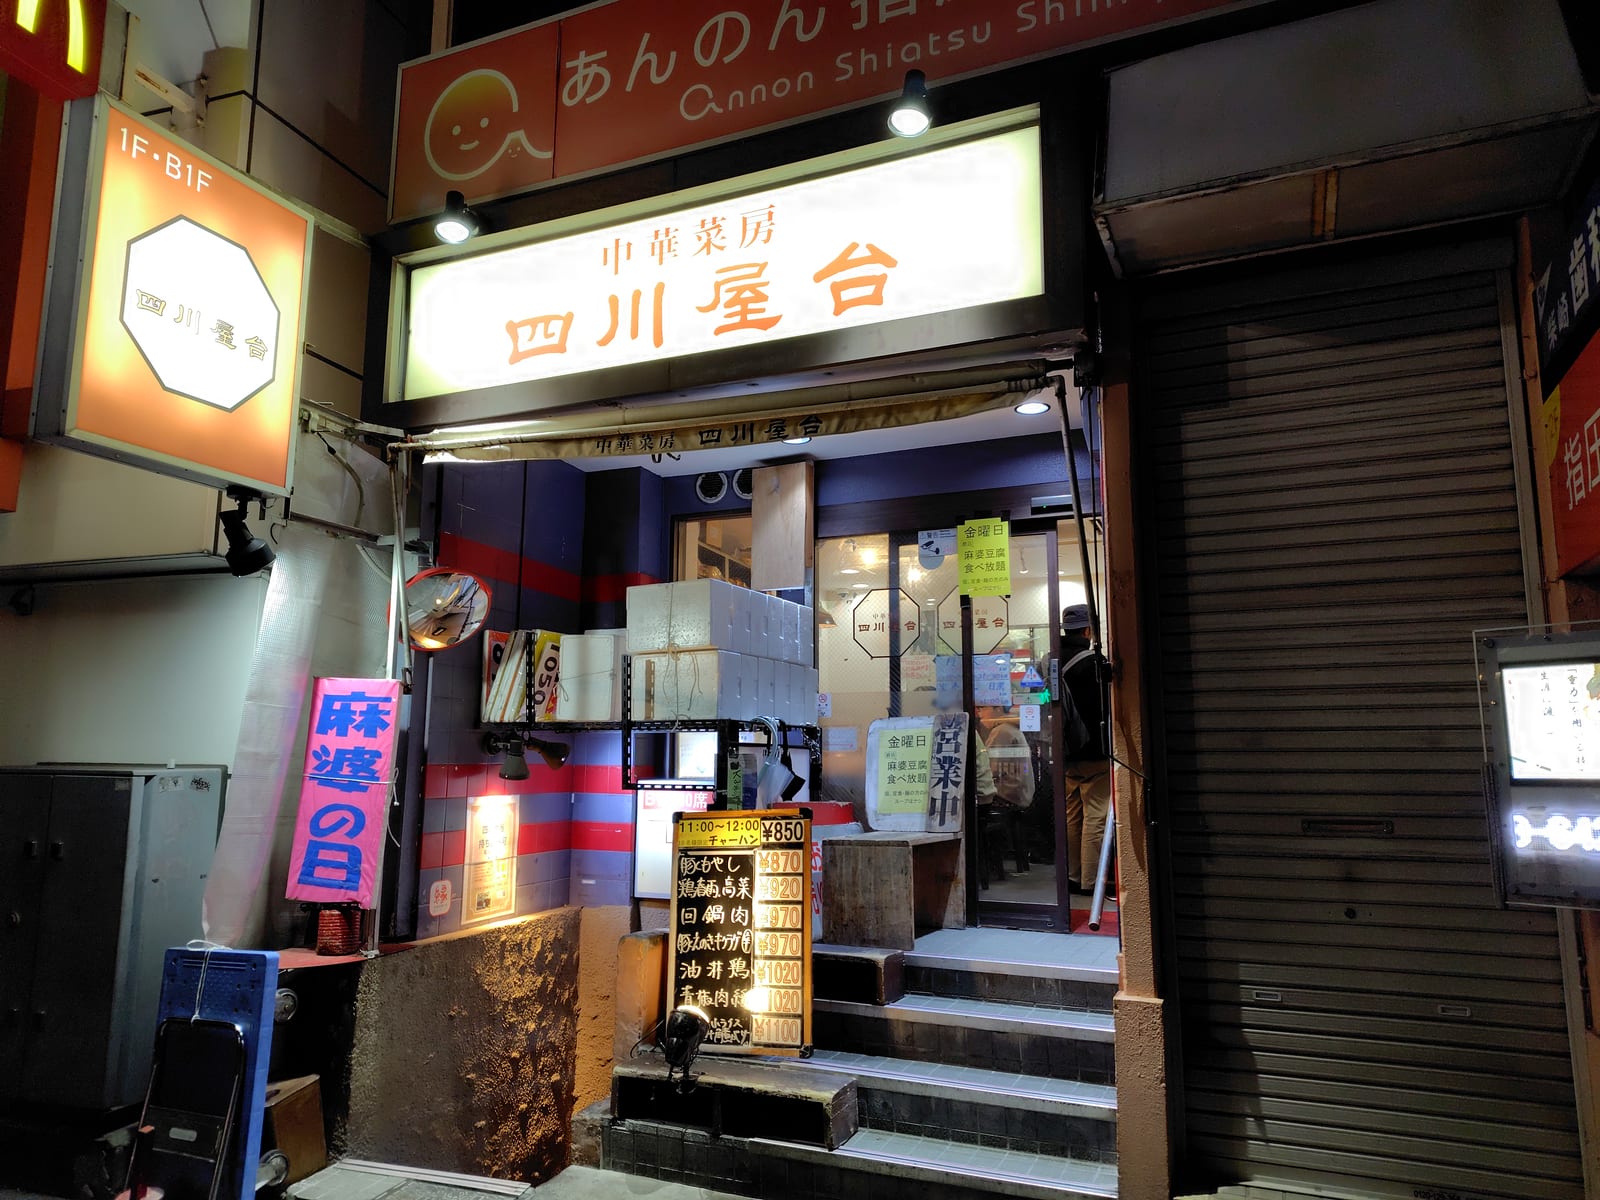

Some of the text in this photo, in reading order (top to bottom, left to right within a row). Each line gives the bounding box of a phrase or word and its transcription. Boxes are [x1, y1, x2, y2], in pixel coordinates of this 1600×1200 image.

[834, 21, 992, 83] Shiatsu
[602, 203, 776, 276] 中華菜房
[505, 241, 898, 365] 四川屋台
[136, 288, 268, 361] 四川屋台
[699, 414, 824, 445] 四川屋台
[597, 431, 676, 454] 中華菜房
[963, 524, 1004, 539] 金曜日
[964, 548, 1006, 560] 麻婆豆腐
[964, 561, 1006, 574] 食べ放題
[943, 617, 1005, 629] 四屋台
[887, 735, 926, 749] 金曜日
[887, 760, 928, 771] 麻婆豆腐
[928, 714, 962, 827] 営業中
[887, 773, 928, 784] 食べ放題
[709, 834, 759, 846] チャーハン
